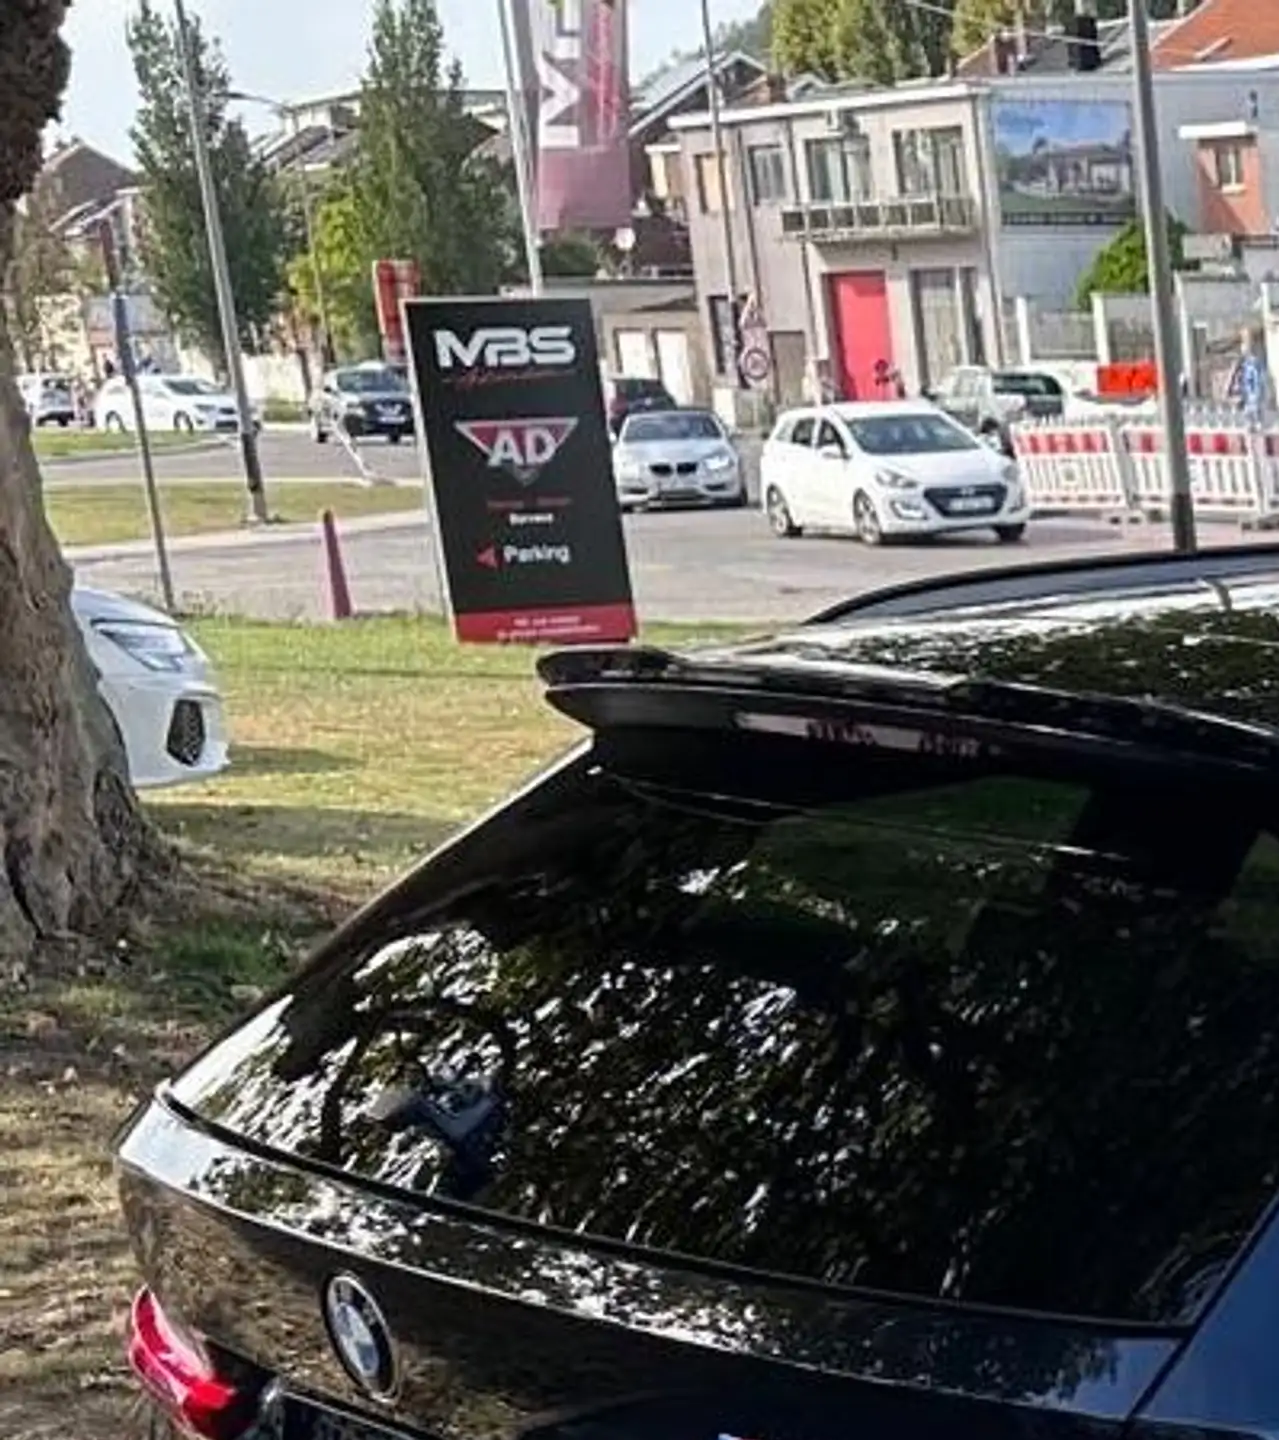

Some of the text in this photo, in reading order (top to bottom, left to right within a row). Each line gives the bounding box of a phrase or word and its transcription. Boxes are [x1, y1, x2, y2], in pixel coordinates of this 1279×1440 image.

[433, 326, 576, 369] MBS
[488, 424, 557, 467] AD
[503, 545, 571, 563] Parking
